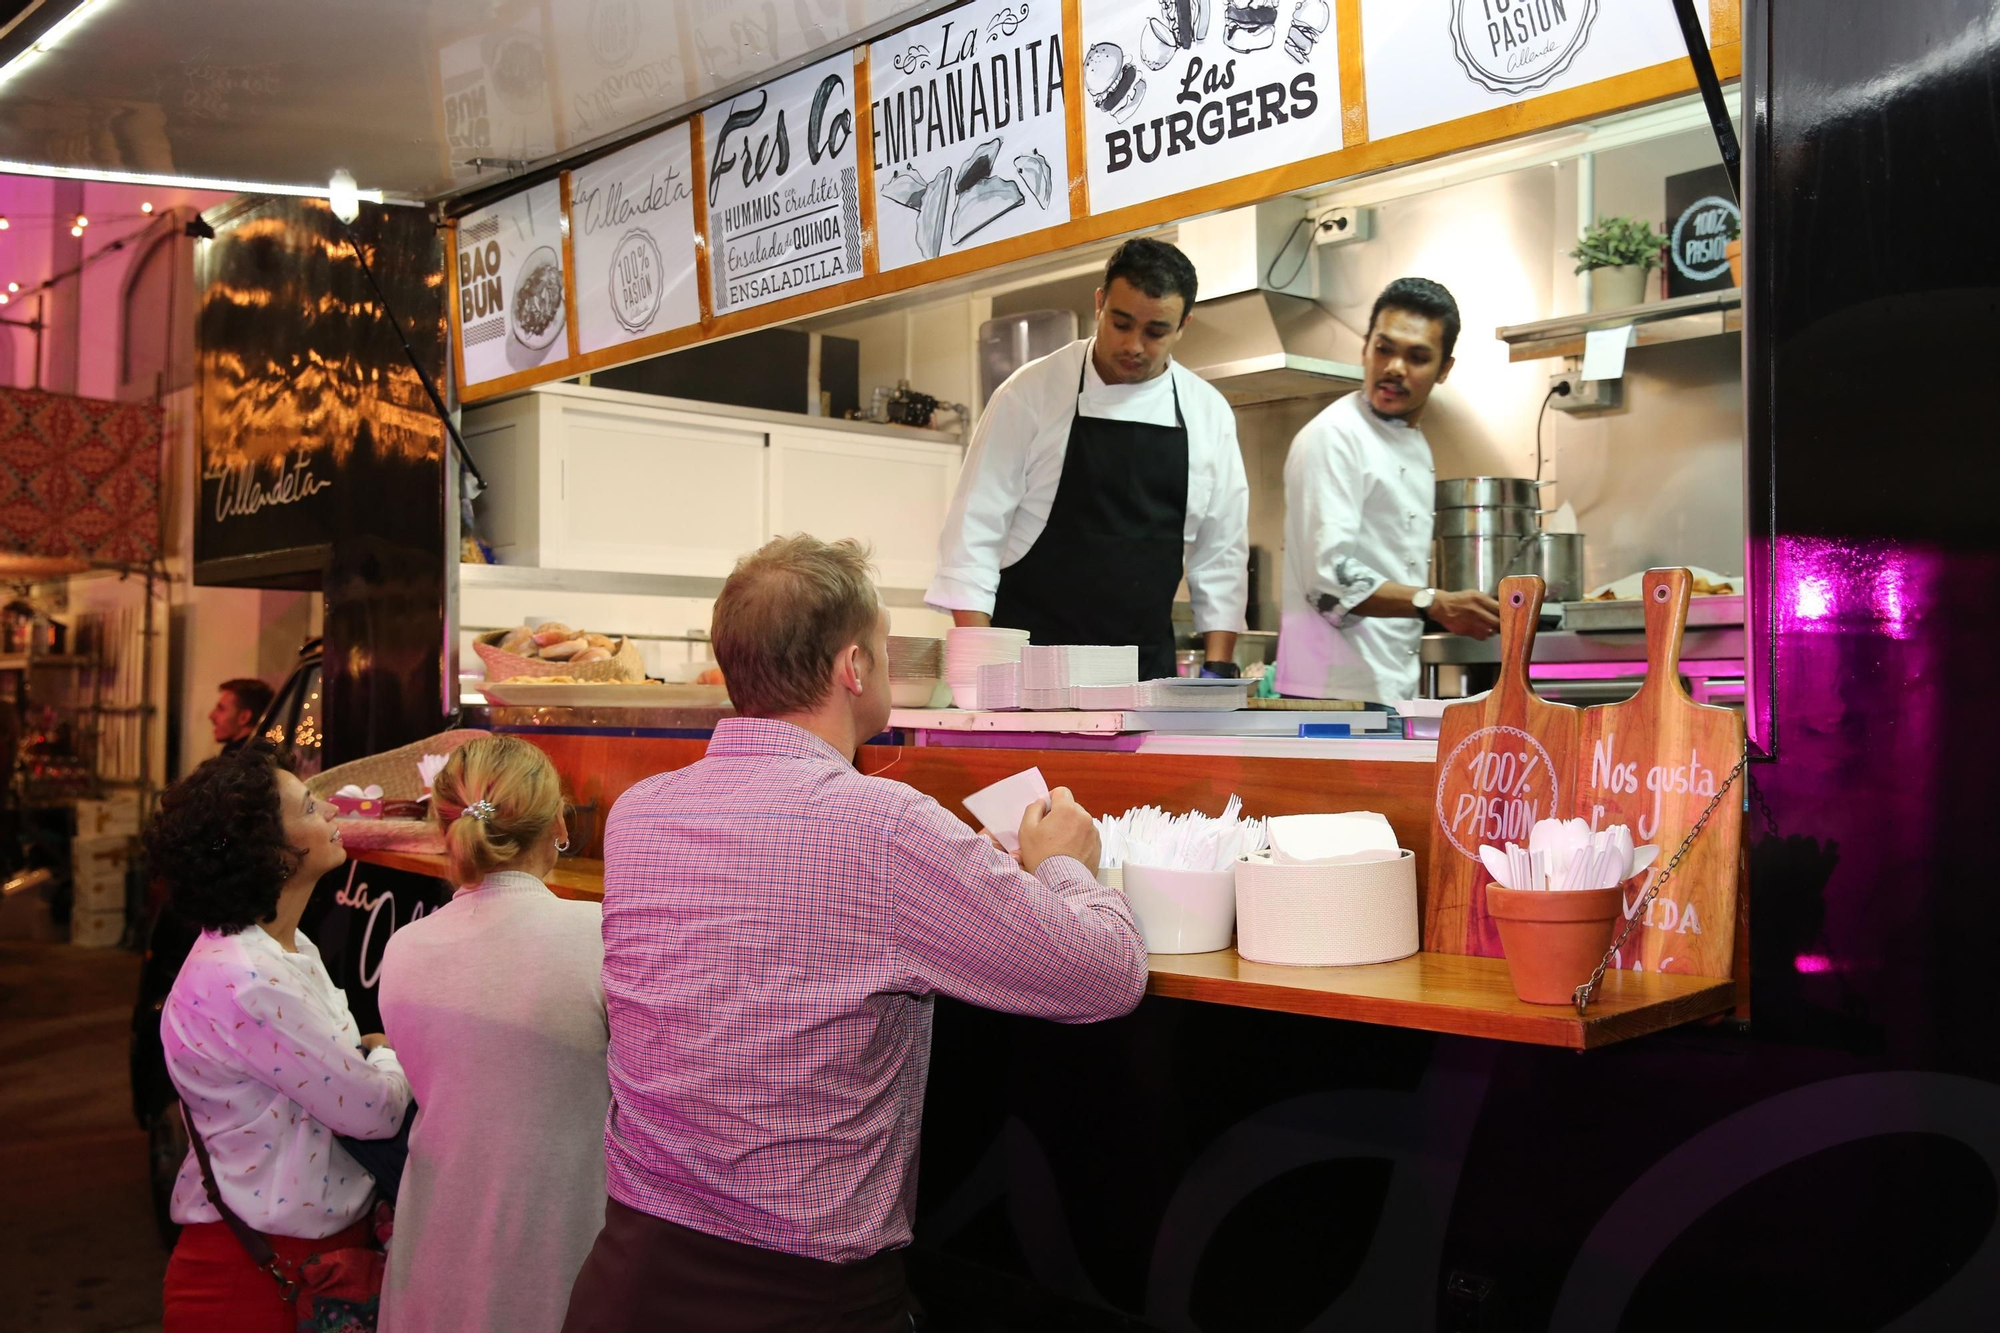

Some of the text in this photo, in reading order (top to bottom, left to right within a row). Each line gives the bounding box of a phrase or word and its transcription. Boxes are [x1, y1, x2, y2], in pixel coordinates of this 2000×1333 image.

[935, 21, 979, 72] La
[1506, 38, 1562, 74] Allende
[871, 33, 1066, 172] EMPANADITA
[1175, 56, 1237, 106] Las
[1105, 71, 1319, 174] BURGERS
[725, 191, 781, 233] HUMMUS
[785, 176, 842, 213] crudités
[1693, 208, 1730, 237] 100%
[460, 240, 501, 288] BAO
[618, 243, 650, 288] 100%
[727, 215, 842, 272] Ensalada de QUINOA
[462, 276, 504, 323] BUN
[623, 272, 653, 310] PASIÓN
[729, 256, 845, 305] ENSALADILLA
[1468, 750, 1539, 797] 100%
[1591, 732, 1717, 841] Nos gusta
[1452, 792, 1538, 840] PASIÓN
[336, 859, 379, 912] La
[1622, 867, 1702, 935] VIDA
